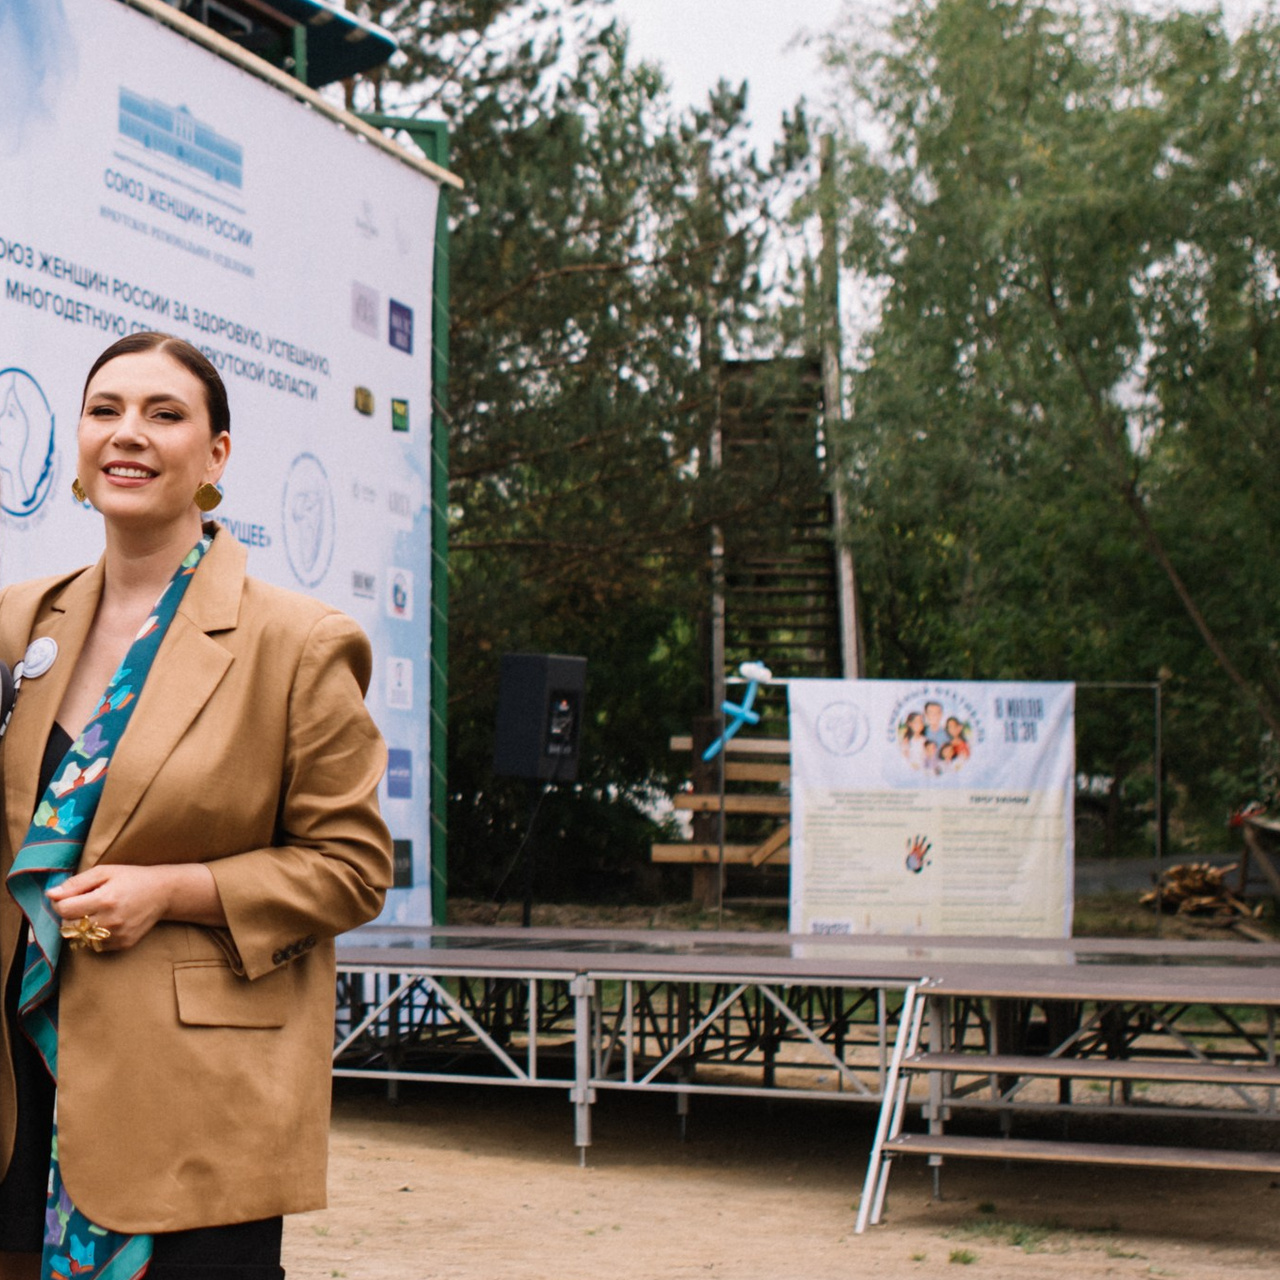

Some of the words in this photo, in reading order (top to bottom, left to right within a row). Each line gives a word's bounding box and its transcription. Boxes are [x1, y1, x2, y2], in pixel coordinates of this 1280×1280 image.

[104, 168, 144, 202] СОЮЗ
[148, 187, 204, 226] ЖЕНЩИН
[206, 212, 253, 248] РОССИИ
[5, 277, 127, 337] МНОГОДЕТНУЮ
[268, 369, 319, 401] ОБЛАСТИ
[39, 251, 110, 295] ЖЕНЩИН
[113, 278, 170, 317] РОССИИ
[173, 300, 190, 324] ЗА
[267, 336, 332, 379] УСПЕШНУЮ,
